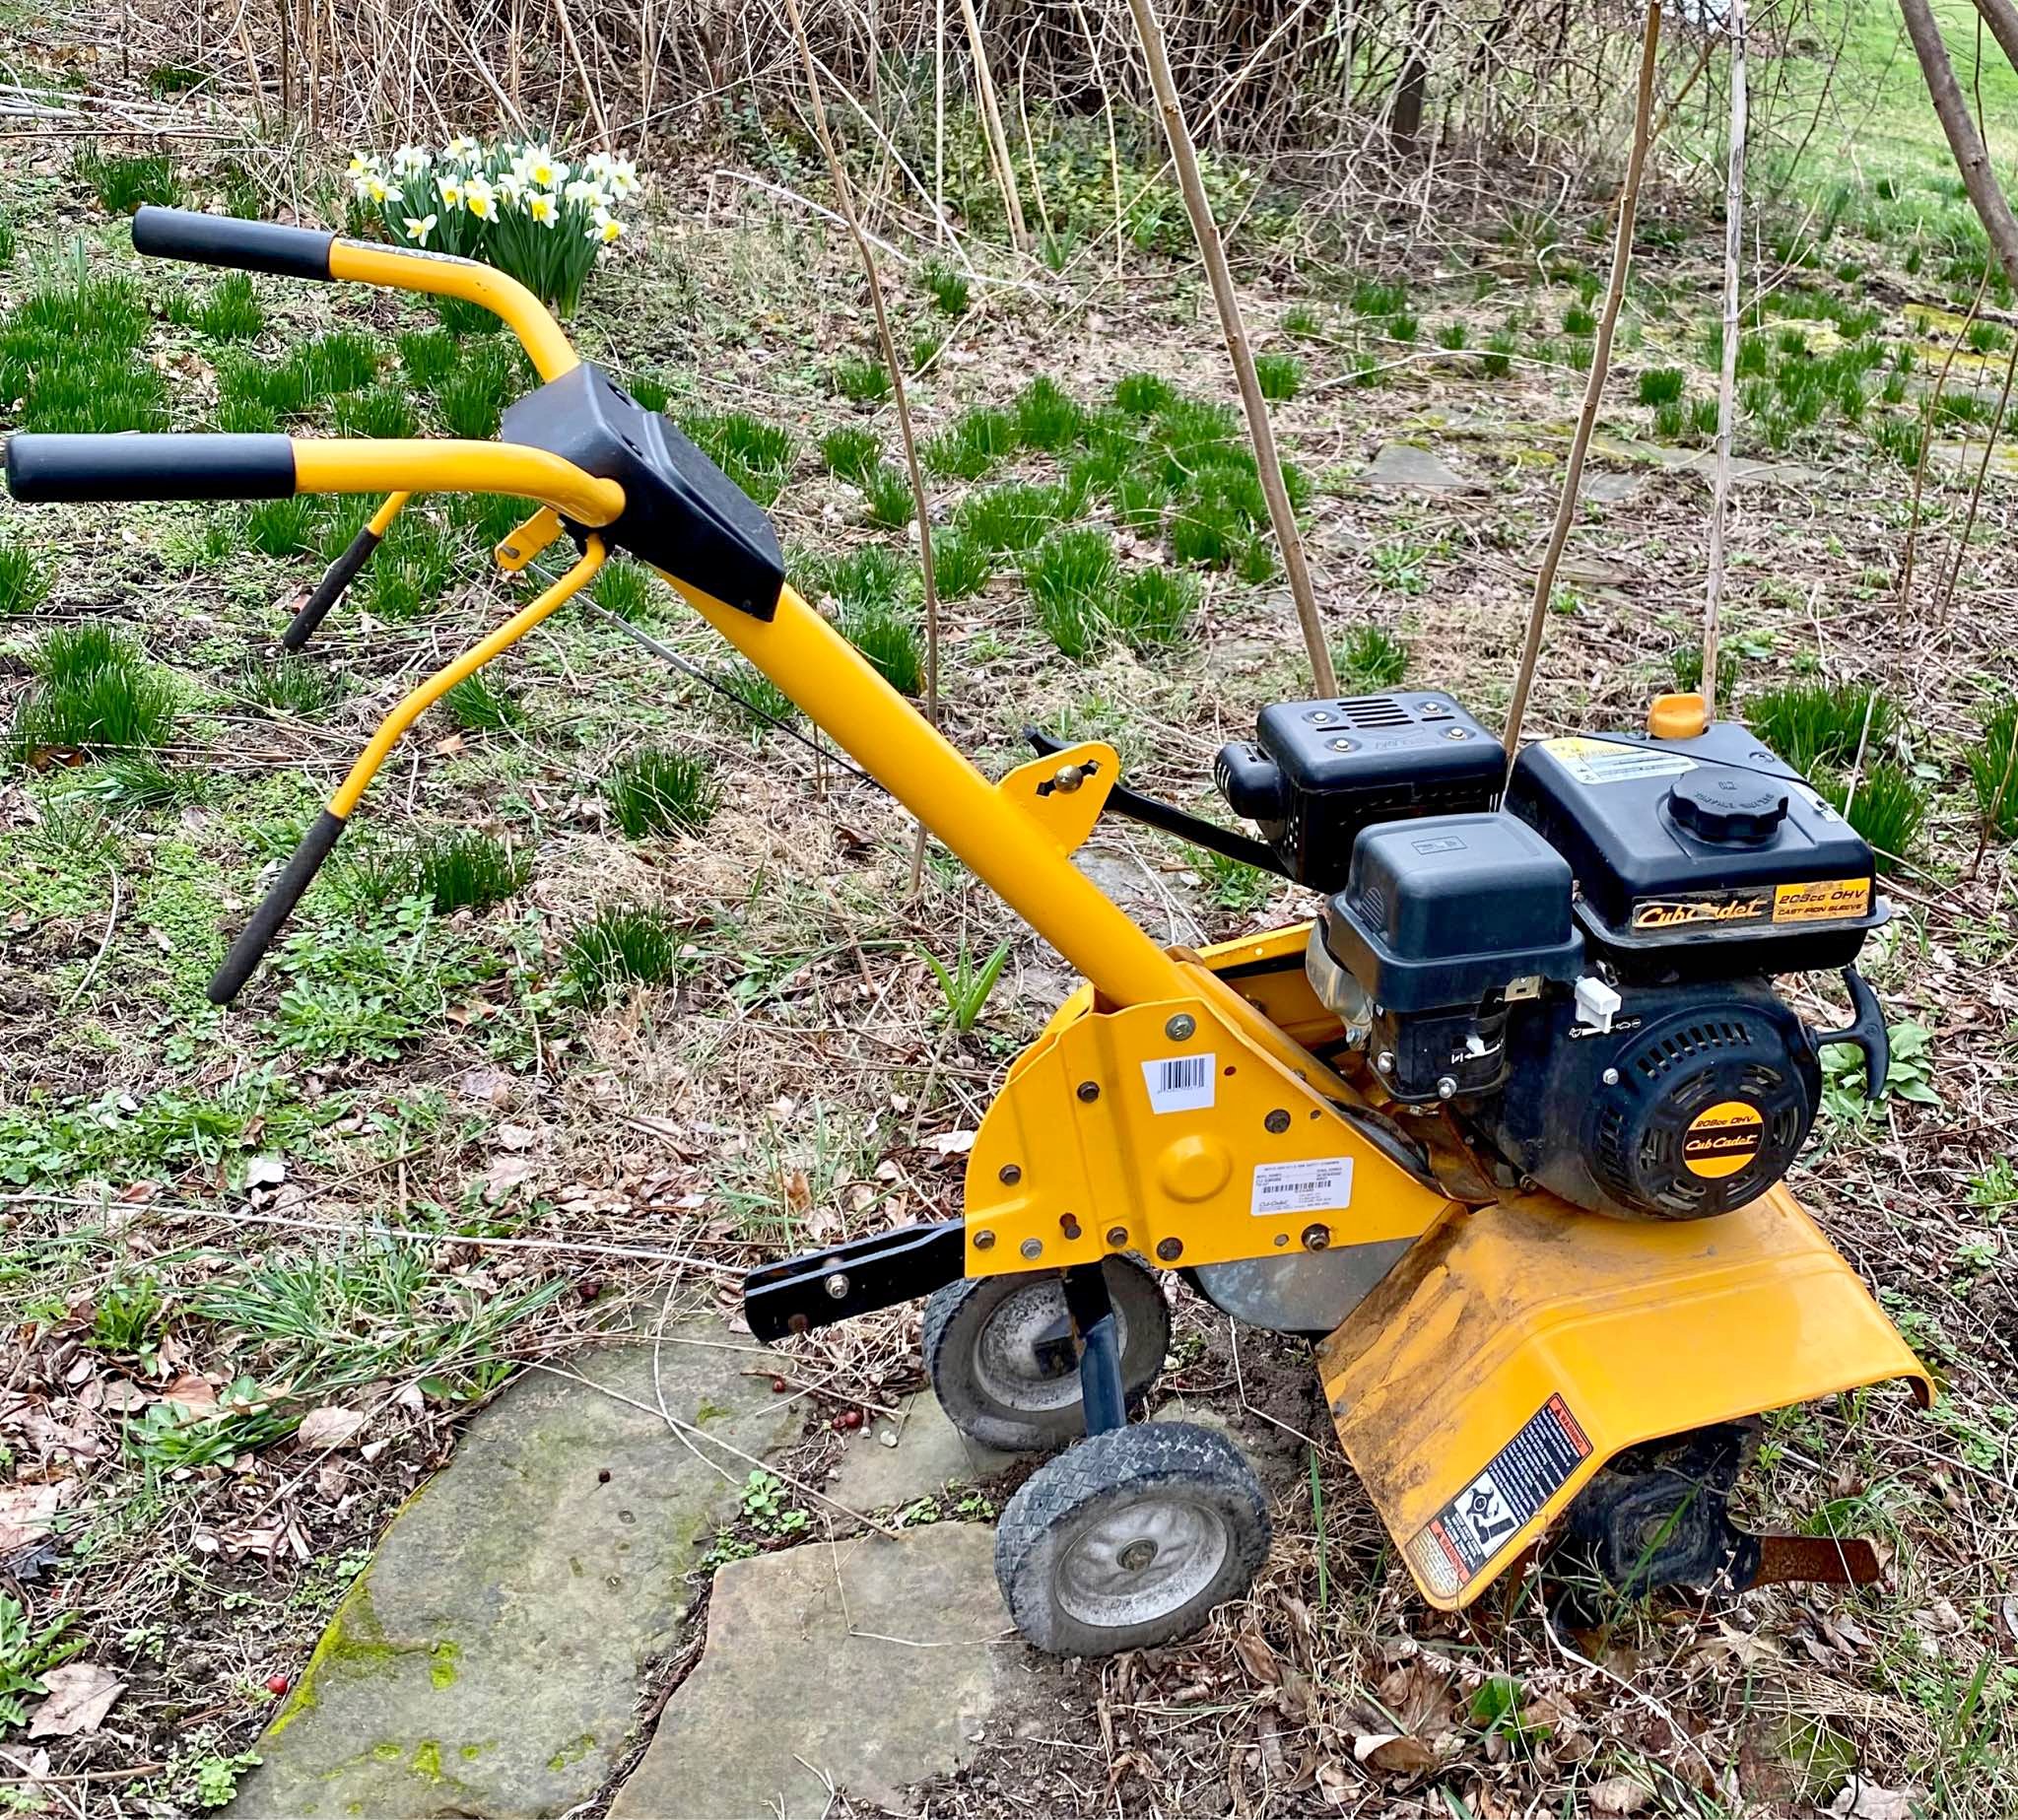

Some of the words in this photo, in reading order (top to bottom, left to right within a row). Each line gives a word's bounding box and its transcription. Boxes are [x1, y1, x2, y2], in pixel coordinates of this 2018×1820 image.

[1831, 889, 1866, 901] OHV
[1636, 903, 1686, 926] Cub
[1778, 908, 1803, 916] CAST
[1803, 905, 1827, 913] IRON
[1827, 903, 1863, 912] SLEEVE
[1729, 1115, 1755, 1125] OHV
[1685, 1138, 1713, 1151] Cub
[1713, 1134, 1759, 1148] Cadet
[1560, 1413, 1583, 1449] WARNING
